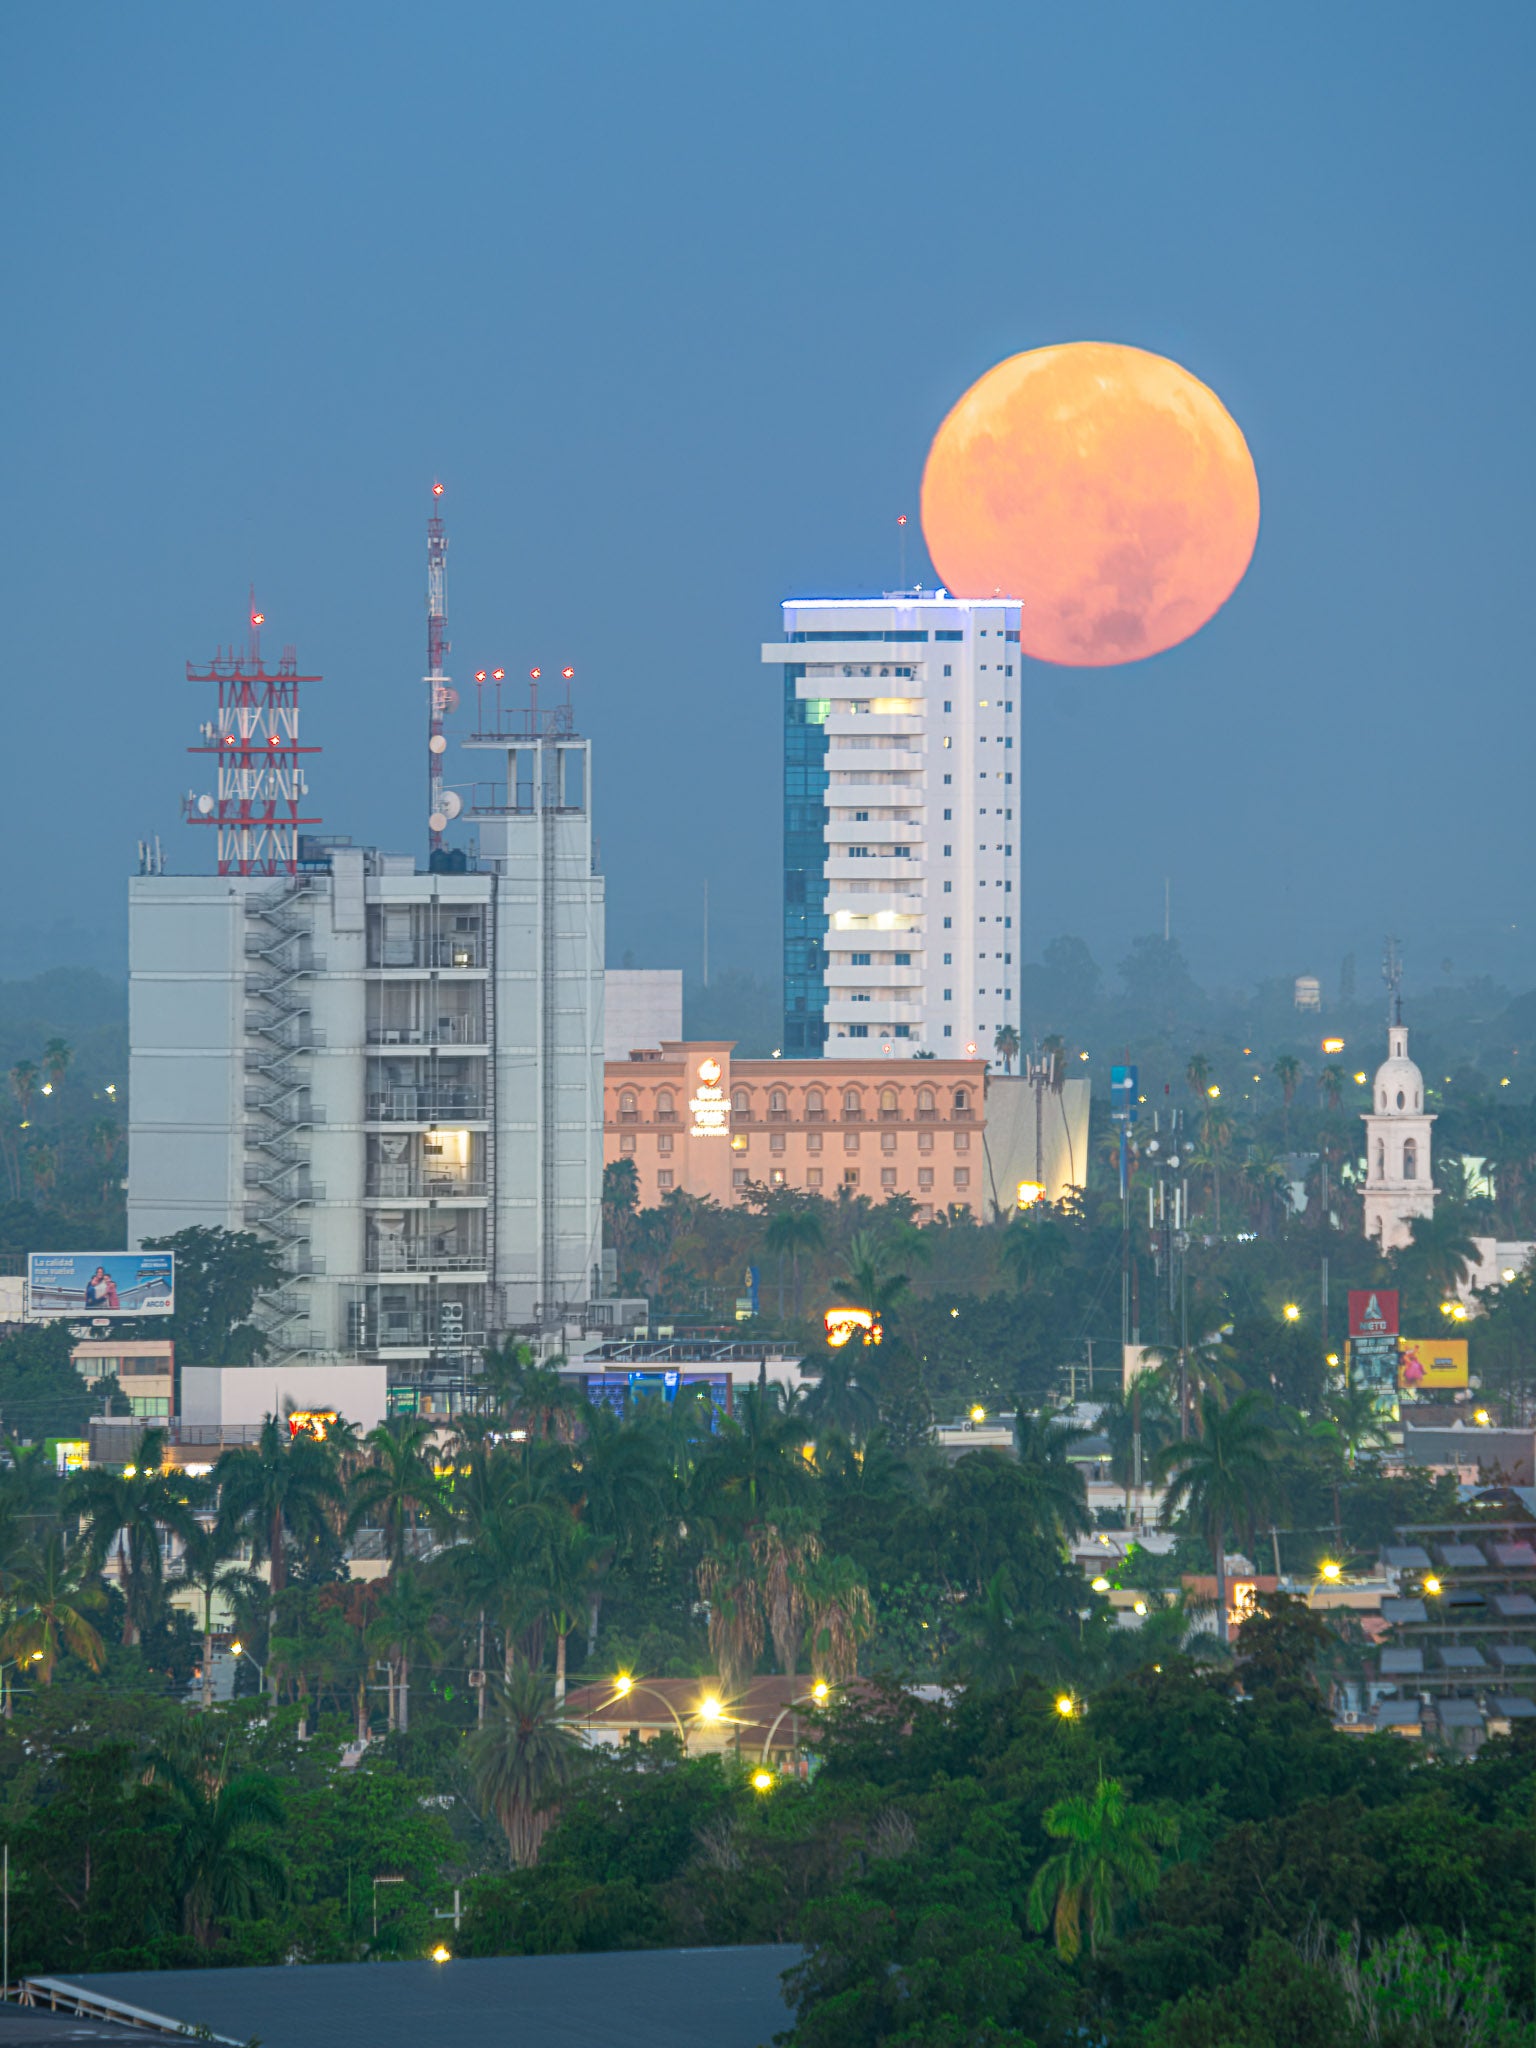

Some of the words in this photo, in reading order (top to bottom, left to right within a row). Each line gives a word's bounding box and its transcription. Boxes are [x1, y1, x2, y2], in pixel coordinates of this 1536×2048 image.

[34, 1258, 45, 1267] La
[45, 1258, 74, 1267] calidad
[1359, 1321, 1387, 1330] NIETO
